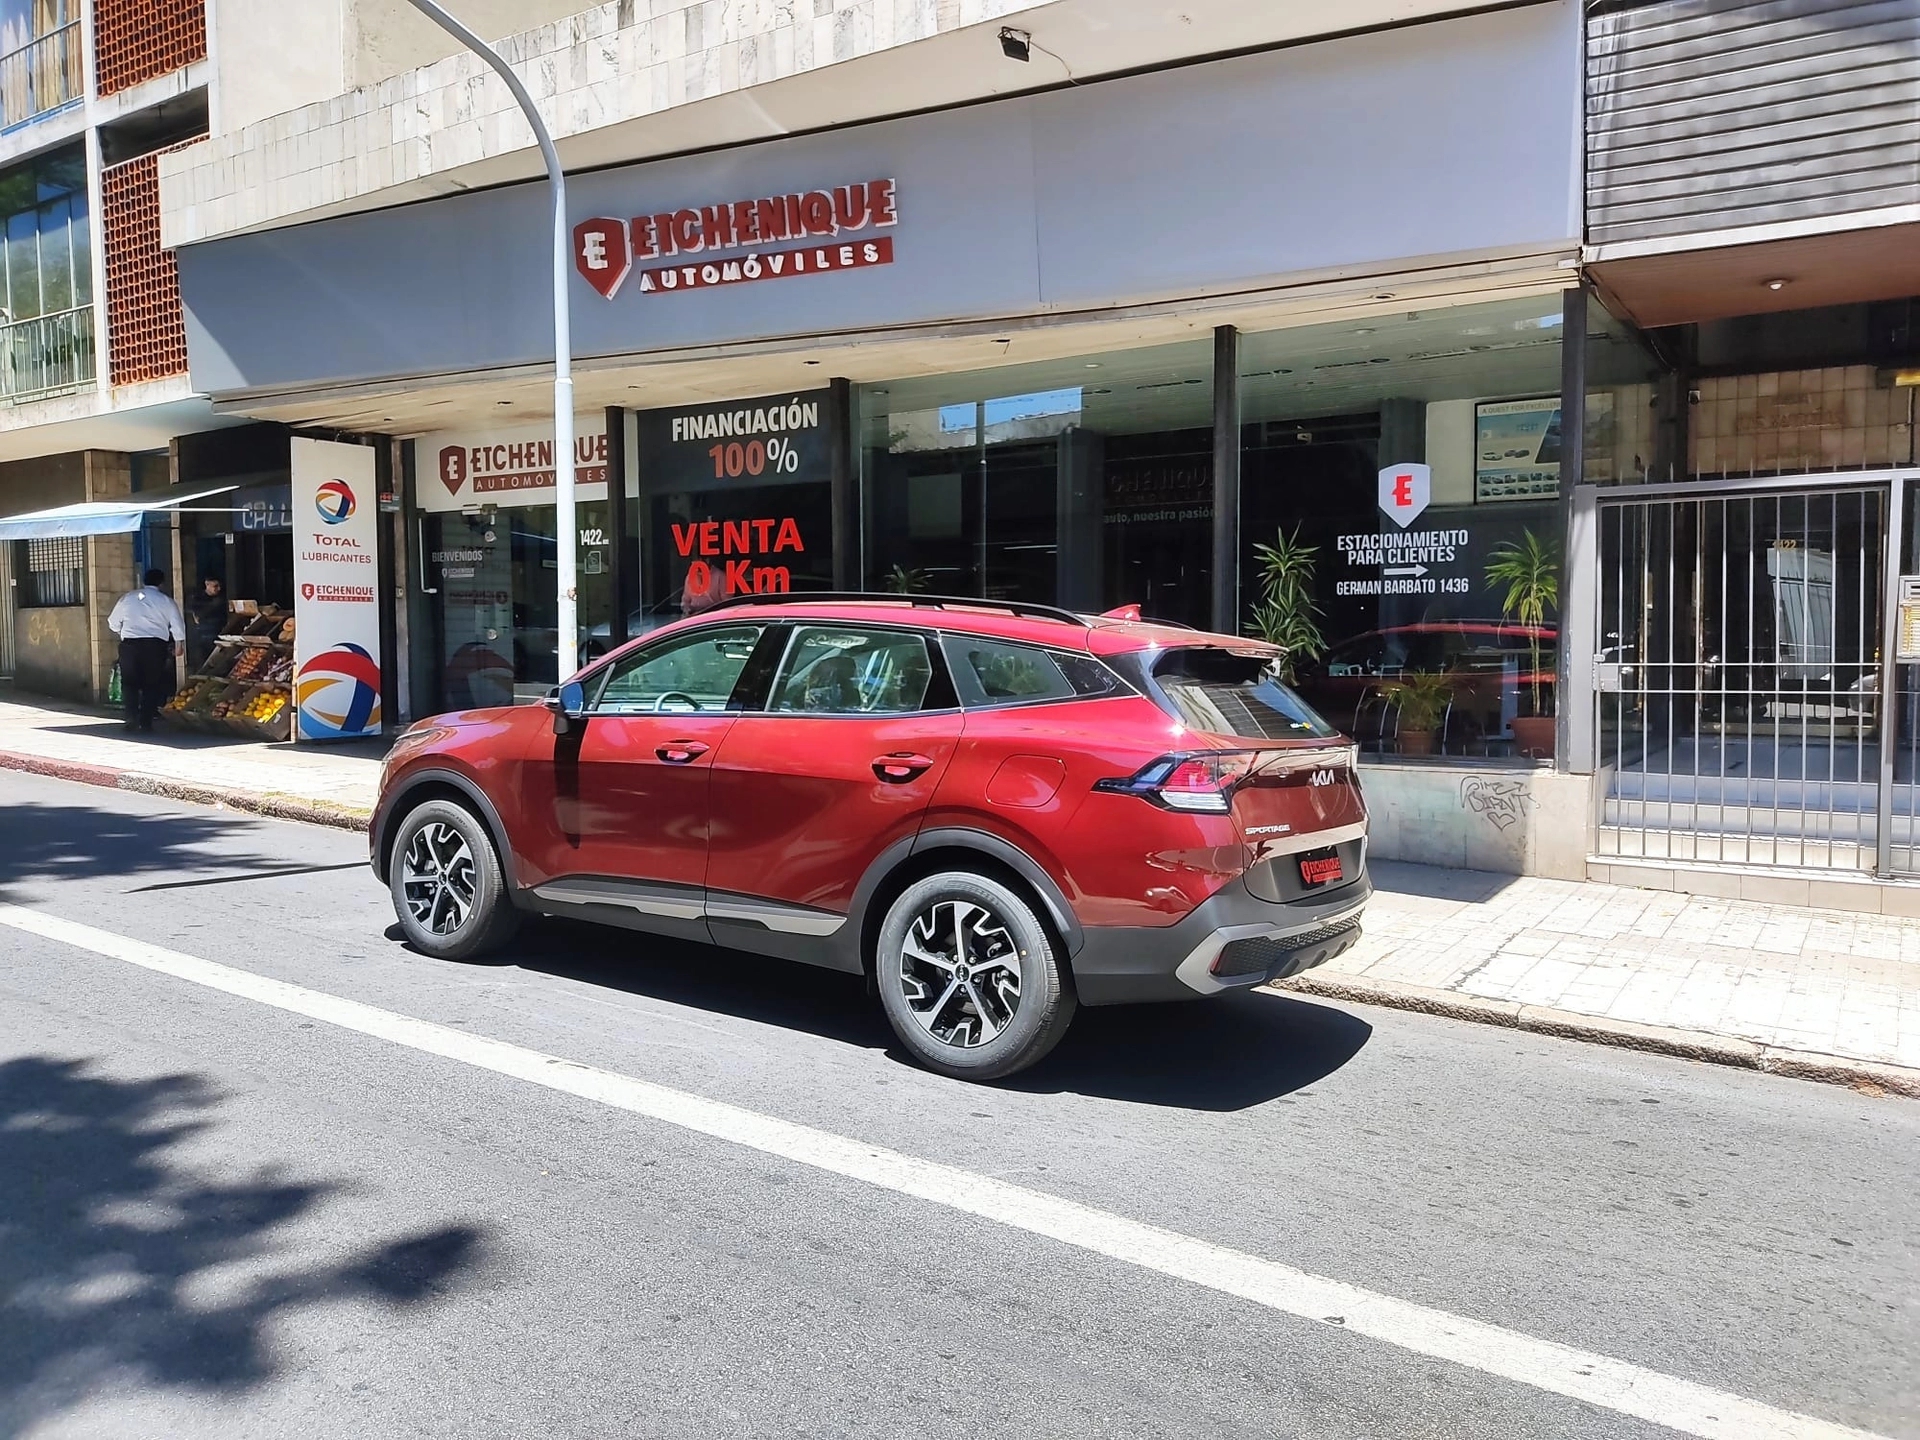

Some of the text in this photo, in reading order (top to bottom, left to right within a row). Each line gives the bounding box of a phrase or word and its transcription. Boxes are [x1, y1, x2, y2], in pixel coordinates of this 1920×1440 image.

[632, 178, 898, 261] ETCHENIQUE
[639, 243, 880, 292] AUTOMÓVILES
[672, 397, 818, 442] FINANCIACIÓN
[470, 434, 608, 473] ETCHENUE
[708, 437, 799, 478] 100%
[476, 468, 606, 490] AUTOMÓVLES
[1133, 509, 1176, 521] nuestra
[312, 533, 361, 547] TOTAL
[580, 528, 603, 545] 1422
[671, 517, 804, 557] VENTA
[1337, 530, 1469, 551] ESTACIONAMIENTO
[302, 551, 372, 564] LUBRICANTES
[431, 550, 483, 562] BIENVENIDOS
[1347, 546, 1456, 566] PARA CLIENTES
[687, 559, 790, 596] 0 Km
[1336, 578, 1469, 596] GERMAN BARBATO 1436
[316, 585, 375, 596] ETCHENIQUE
[1245, 824, 1291, 835] SPORTAGE
